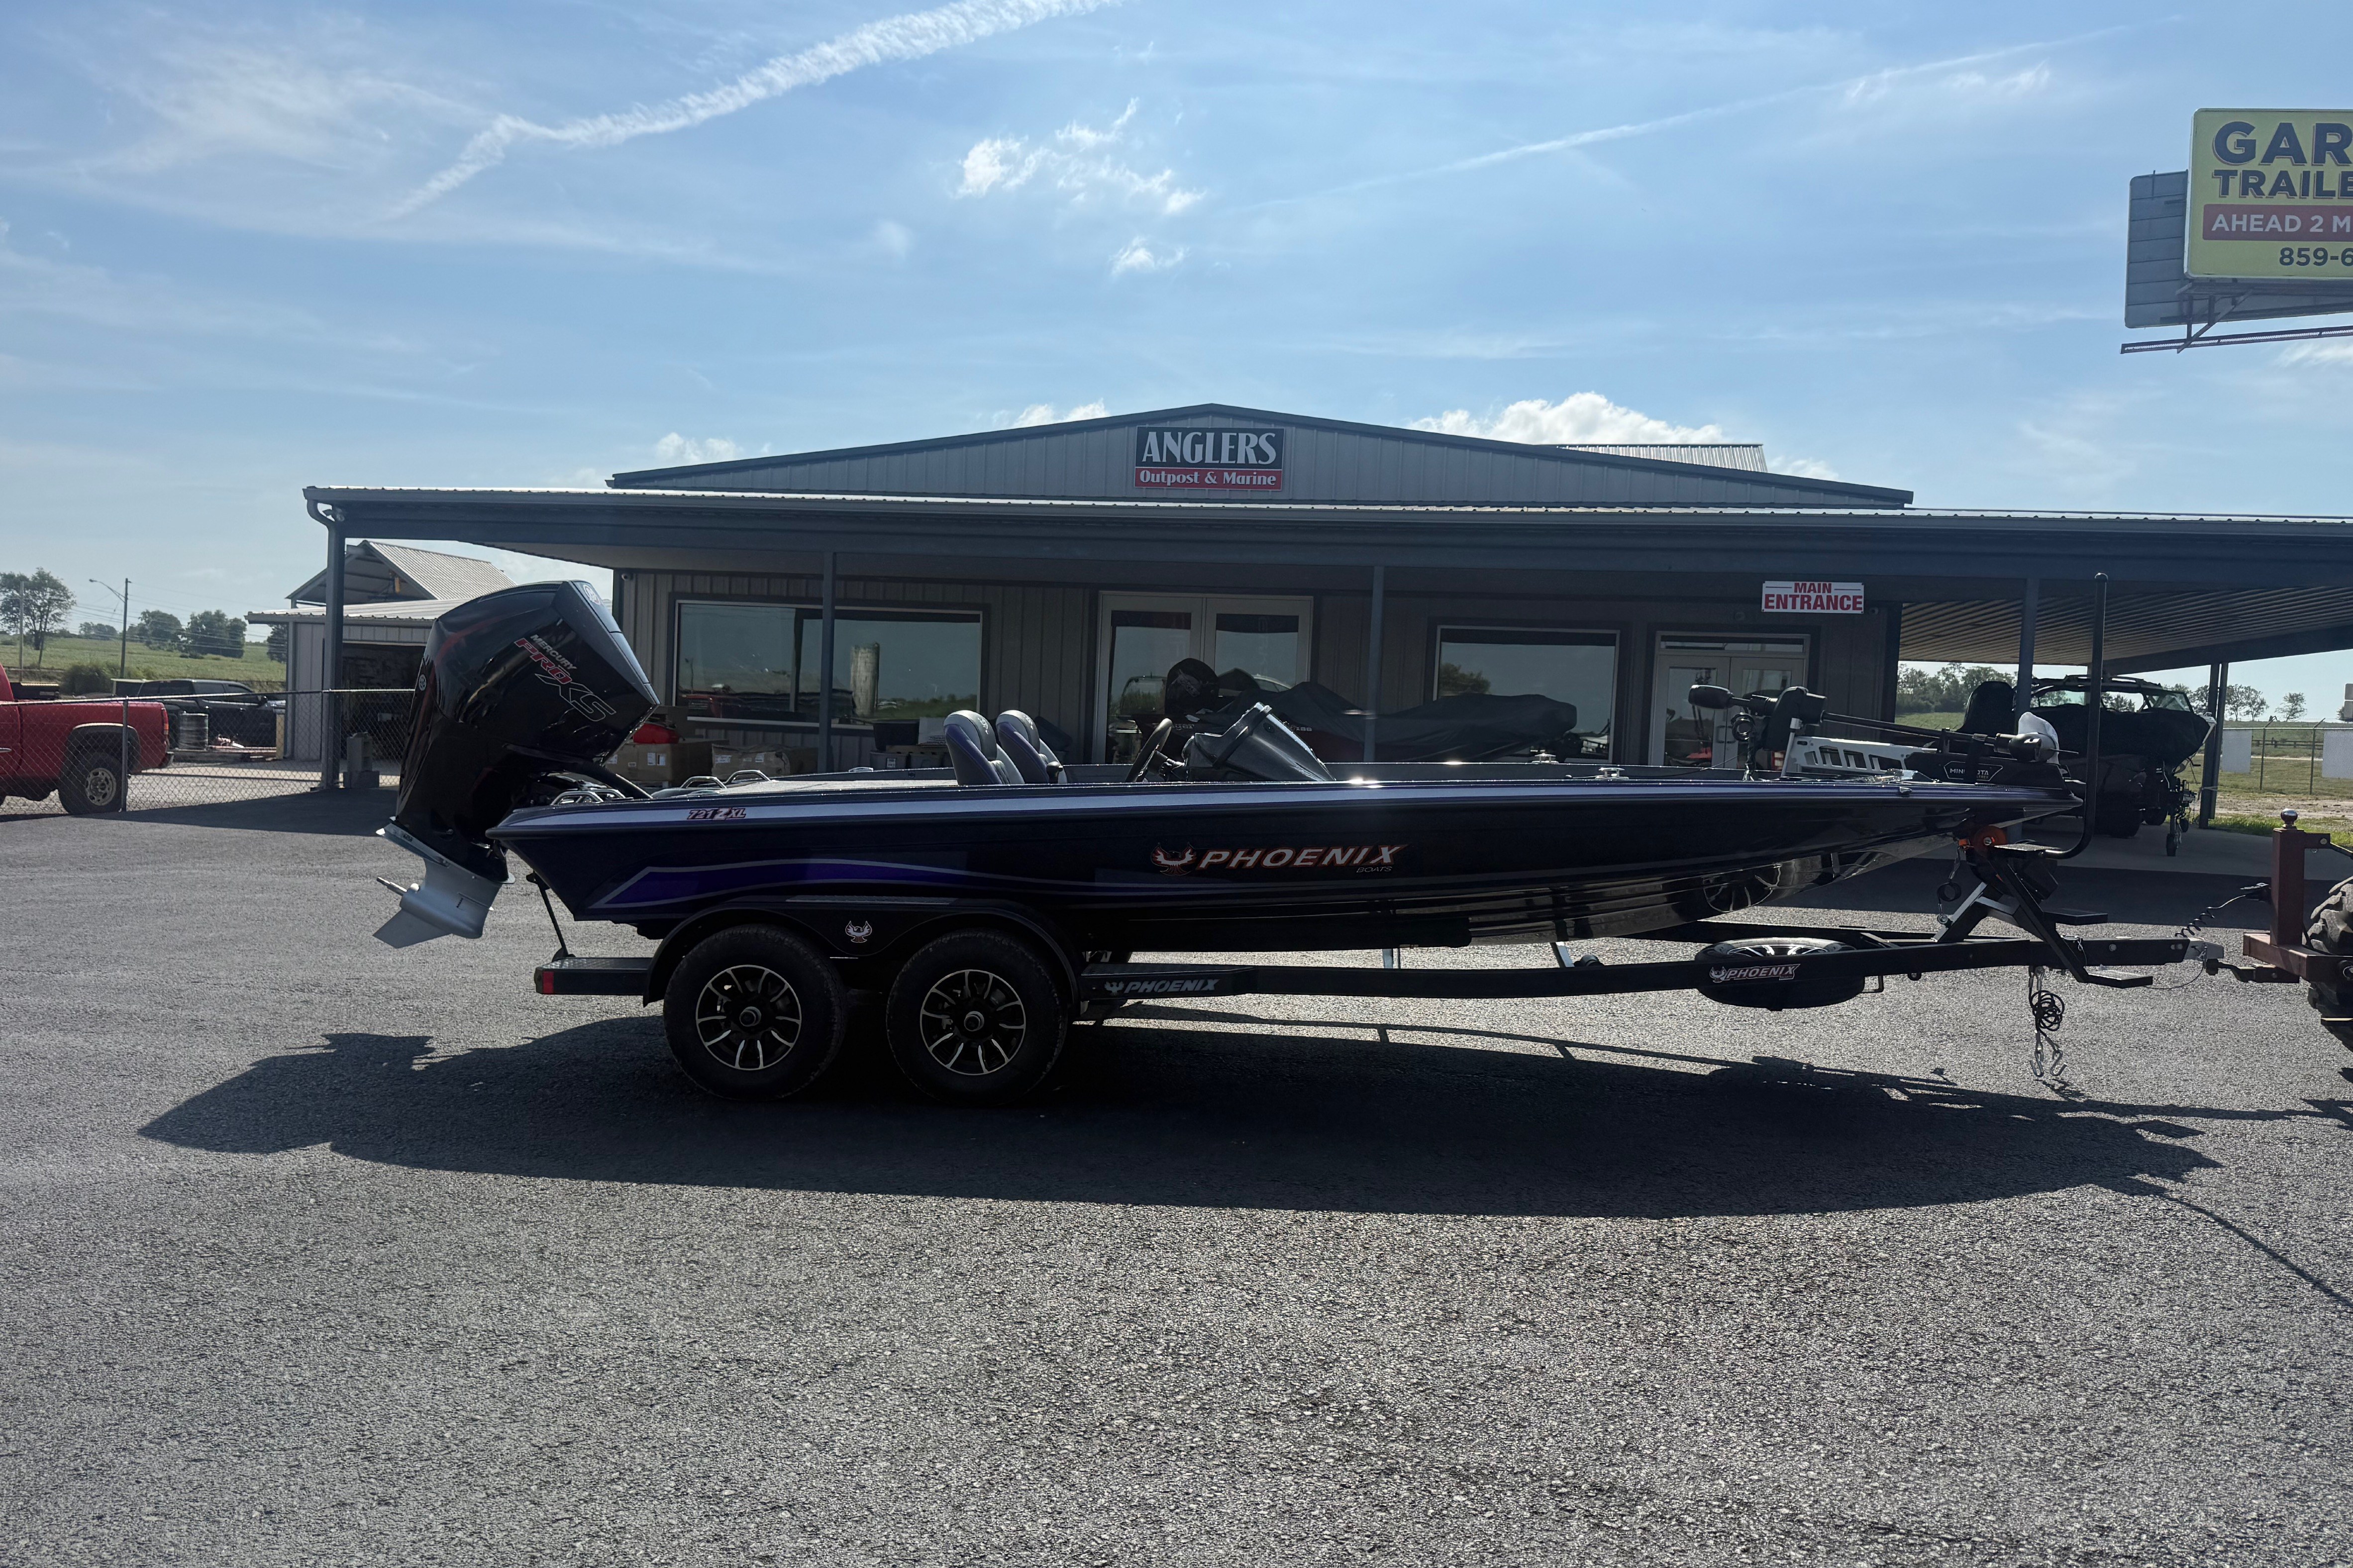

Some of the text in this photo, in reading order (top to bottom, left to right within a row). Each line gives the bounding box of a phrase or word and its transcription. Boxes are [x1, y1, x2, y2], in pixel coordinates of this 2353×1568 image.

[2213, 121, 2353, 166] GAR
[2211, 214, 2351, 232] AHEAD 2 M
[2279, 247, 2353, 267] 859-6
[1142, 431, 1277, 465] ANGLERS
[1140, 470, 1276, 486] Outpost & Marine
[1794, 583, 1832, 593] MAIN
[1764, 593, 1863, 611] ENTRANCE
[514, 638, 572, 685] PRO
[530, 634, 577, 670] MERCURY
[535, 673, 616, 722] XS
[1197, 845, 1404, 870] PHOENIX
[1727, 966, 1795, 979] PHOENIX
[1124, 979, 1220, 993] PHOENIX
